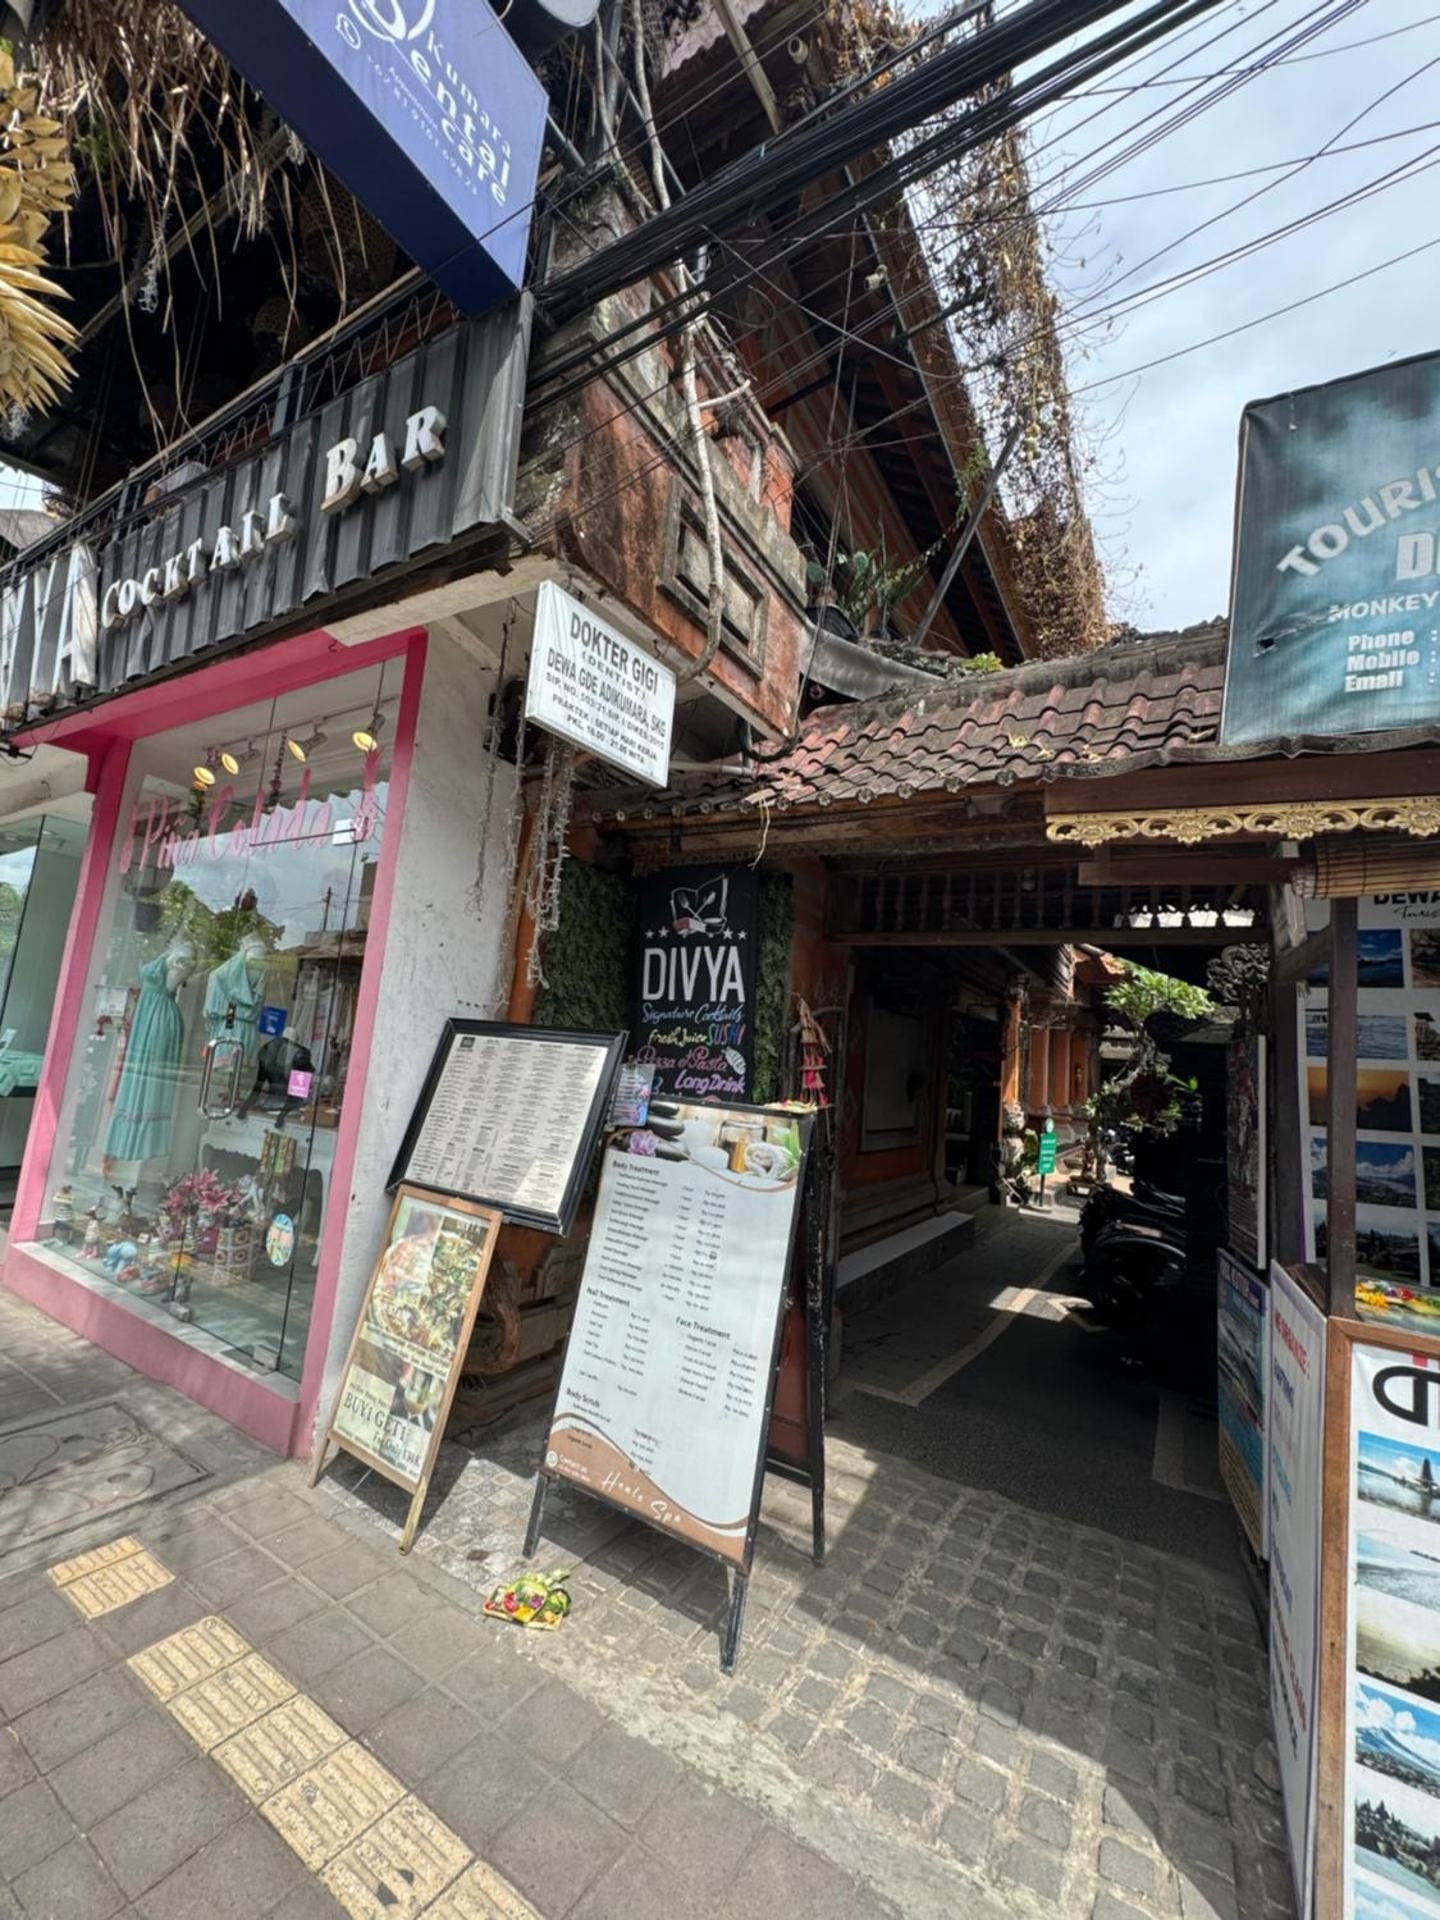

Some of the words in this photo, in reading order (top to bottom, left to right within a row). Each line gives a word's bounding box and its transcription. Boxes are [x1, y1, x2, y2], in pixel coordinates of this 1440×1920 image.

[428, 30, 511, 158] Kumara
[441, 118, 506, 206] care
[102, 492, 299, 629] COCKTAIL
[321, 405, 447, 514] BAR
[1275, 464, 1440, 577] TOURI
[1395, 531, 1440, 581] D
[1328, 591, 1440, 622] MONKEY
[1348, 629, 1415, 651] Phone
[571, 612, 629, 675] DOKTER
[632, 657, 659, 695] GIGI
[1346, 648, 1420, 673] Mobile
[547, 648, 577, 682] DEWA
[578, 667, 599, 695] GDE
[582, 651, 646, 701] (DENTIST)
[1344, 670, 1404, 693] Email
[552, 693, 589, 720] PRAKTEK
[595, 718, 620, 739] SETIAP
[620, 733, 637, 748] HARI
[637, 741, 658, 761] KERJA
[642, 946, 745, 1002] DIVYA
[642, 1002, 695, 1025] Signature
[694, 1002, 745, 1024] Cocktails
[648, 1027, 680, 1047] Fresh
[679, 1027, 708, 1047] Juice
[706, 1023, 747, 1046] SUSHI
[690, 1045, 728, 1071] Pasta
[674, 1069, 709, 1094] Long
[709, 1074, 746, 1095] Drink
[629, 1163, 660, 1176] Treatment
[598, 1289, 630, 1306] Treatment
[676, 1316, 692, 1328] Face
[692, 1320, 731, 1340] Treatment
[566, 1387, 583, 1401] Body
[650, 1500, 681, 1523] Spa
